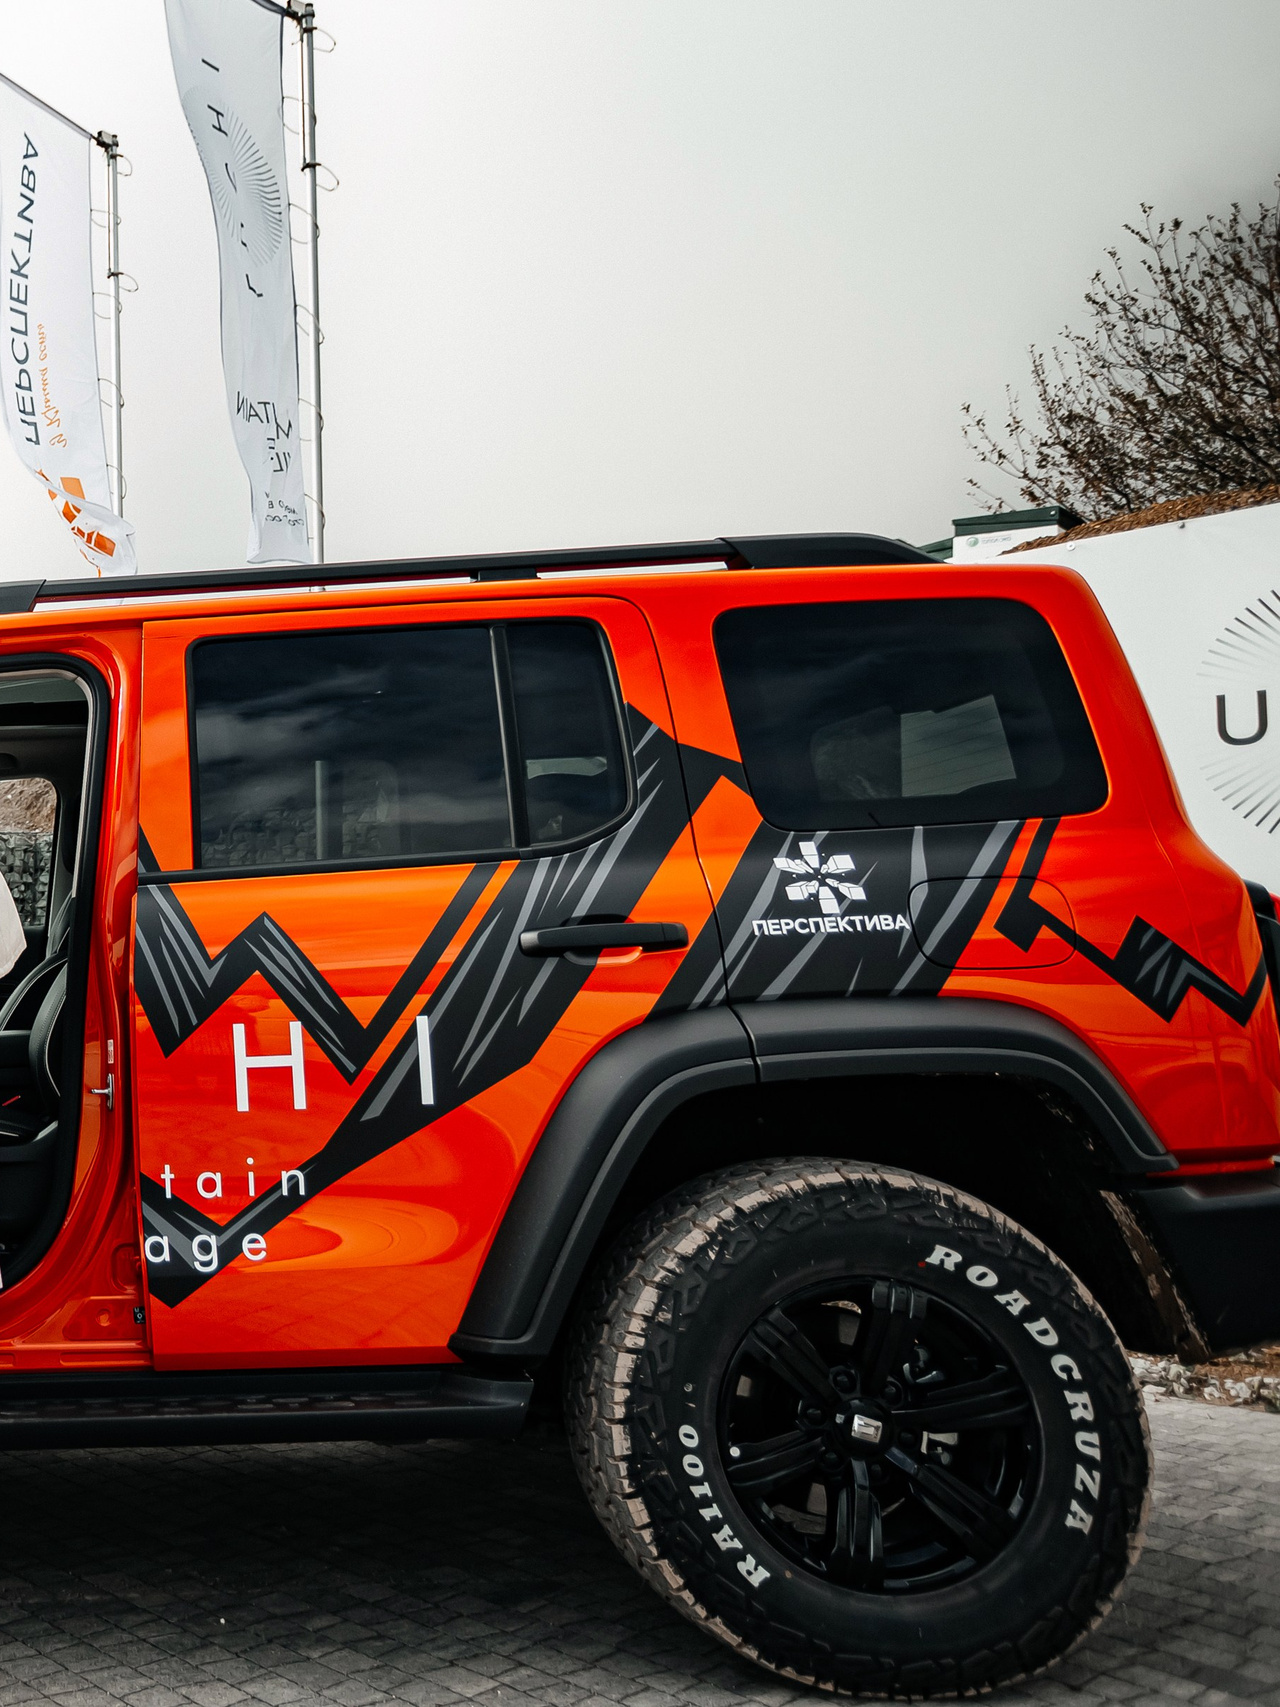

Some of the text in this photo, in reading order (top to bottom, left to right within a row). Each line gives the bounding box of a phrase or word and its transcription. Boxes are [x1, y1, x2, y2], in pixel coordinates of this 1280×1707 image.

[751, 913, 912, 936] ПЕРСПЕКТИВА
[160, 1157, 306, 1199] tain
[144, 1232, 268, 1273] age
[925, 1244, 1104, 1536] ROADCRUZA
